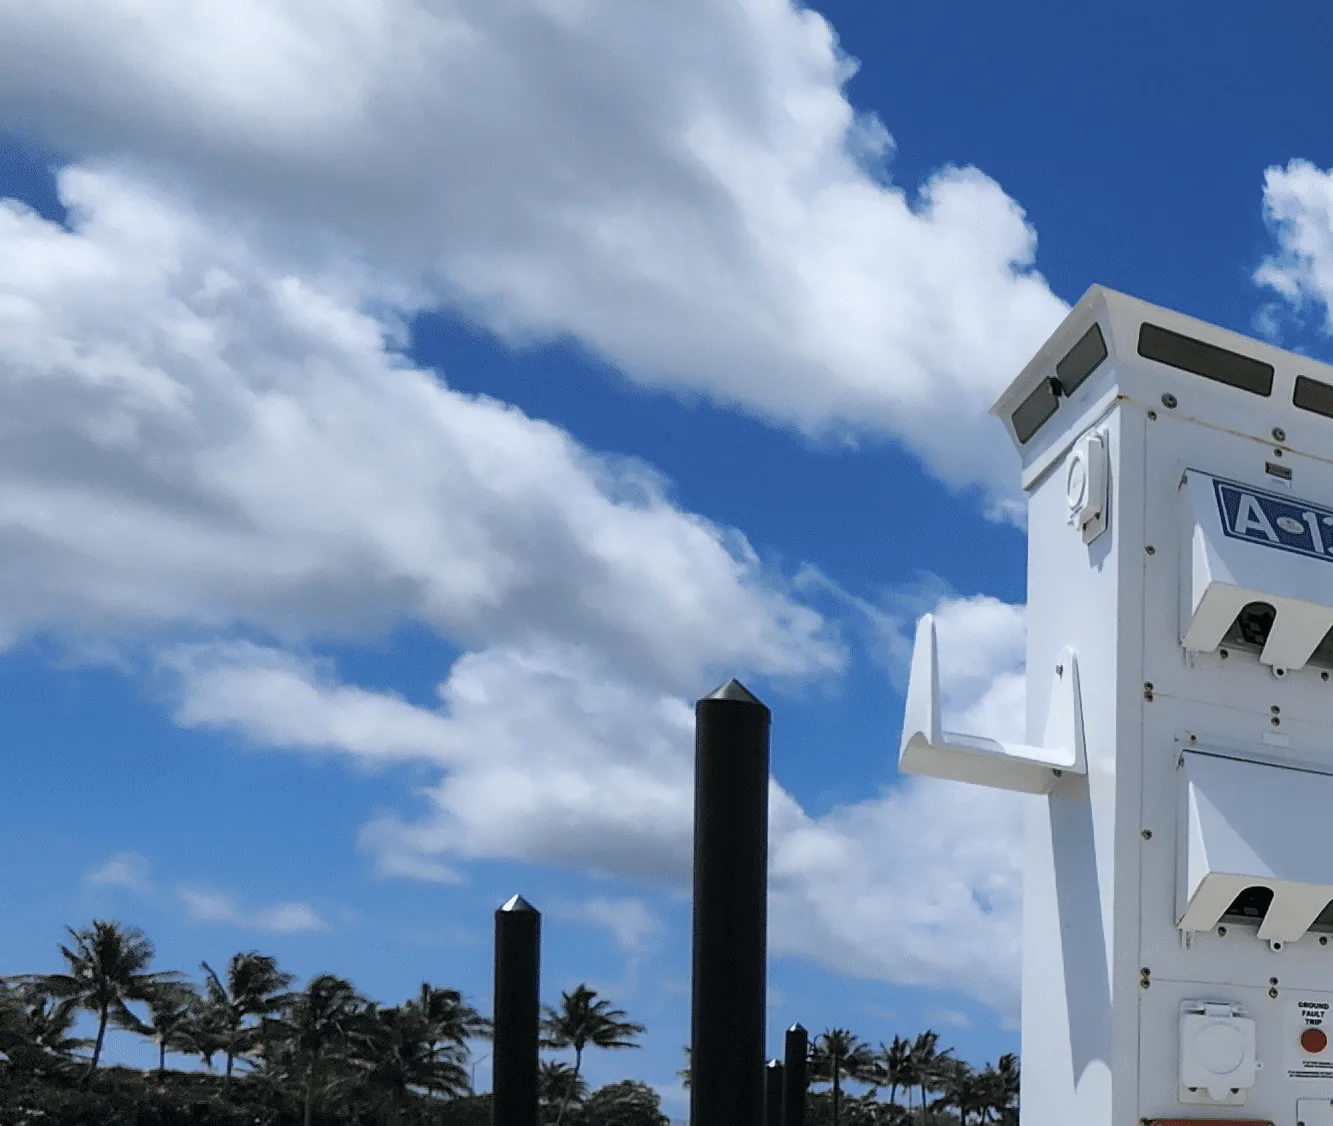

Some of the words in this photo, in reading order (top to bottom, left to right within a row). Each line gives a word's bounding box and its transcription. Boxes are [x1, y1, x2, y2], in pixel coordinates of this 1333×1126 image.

[1298, 1001, 1330, 1010] GROUND
[1301, 1010, 1326, 1018] FAULT
[1305, 1018, 1323, 1026] TRIP
